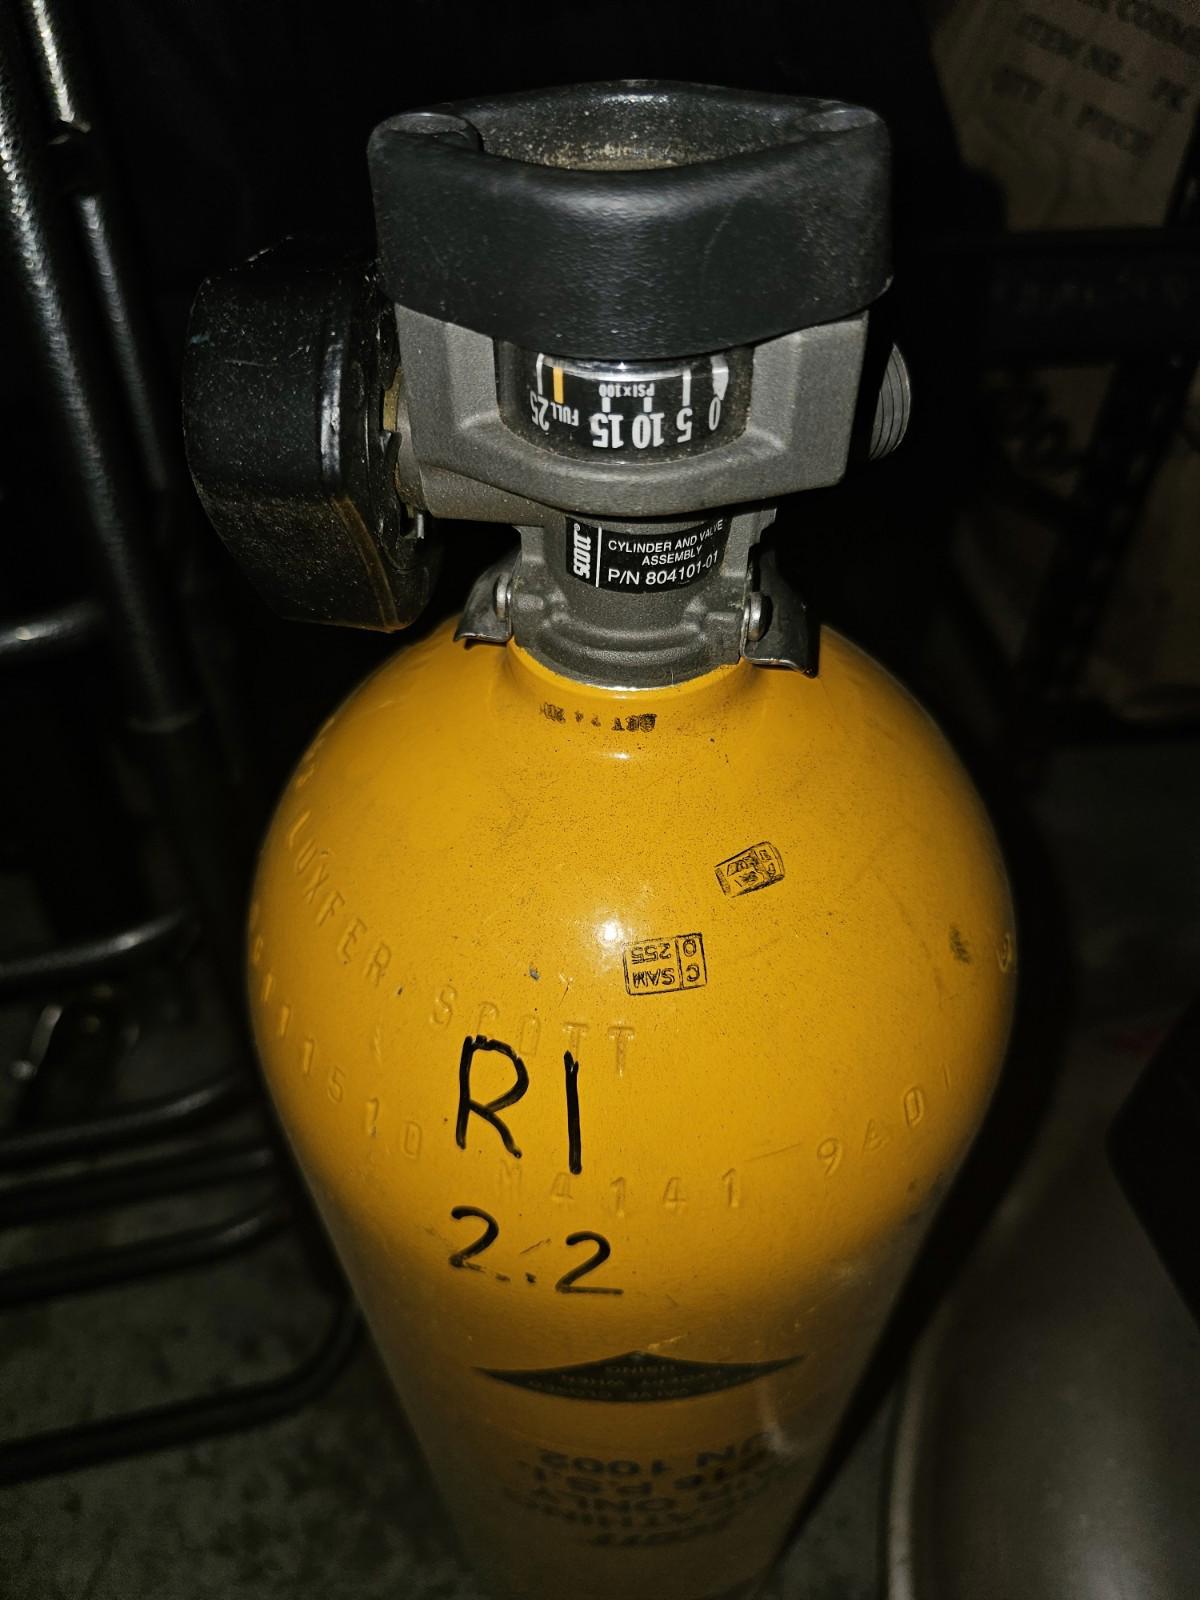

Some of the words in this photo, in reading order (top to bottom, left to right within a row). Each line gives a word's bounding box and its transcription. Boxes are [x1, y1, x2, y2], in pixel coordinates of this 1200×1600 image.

[529, 390, 551, 432] 25
[551, 402, 580, 427] FULL
[676, 407, 693, 444] 5
[708, 395, 722, 432] 0
[590, 412, 624, 449] 15
[631, 412, 665, 450] 10
[607, 539, 673, 554] CYLINDER
[674, 534, 698, 551] AND
[699, 518, 725, 543] VALVE
[607, 568, 641, 586] P/N
[644, 549, 720, 586] 804101-01
[641, 544, 703, 567] ASSEMBLY
[287, 809, 393, 988] LUXFER
[630, 942, 672, 965] 255
[631, 968, 676, 989] SAM
[685, 964, 701, 982] C
